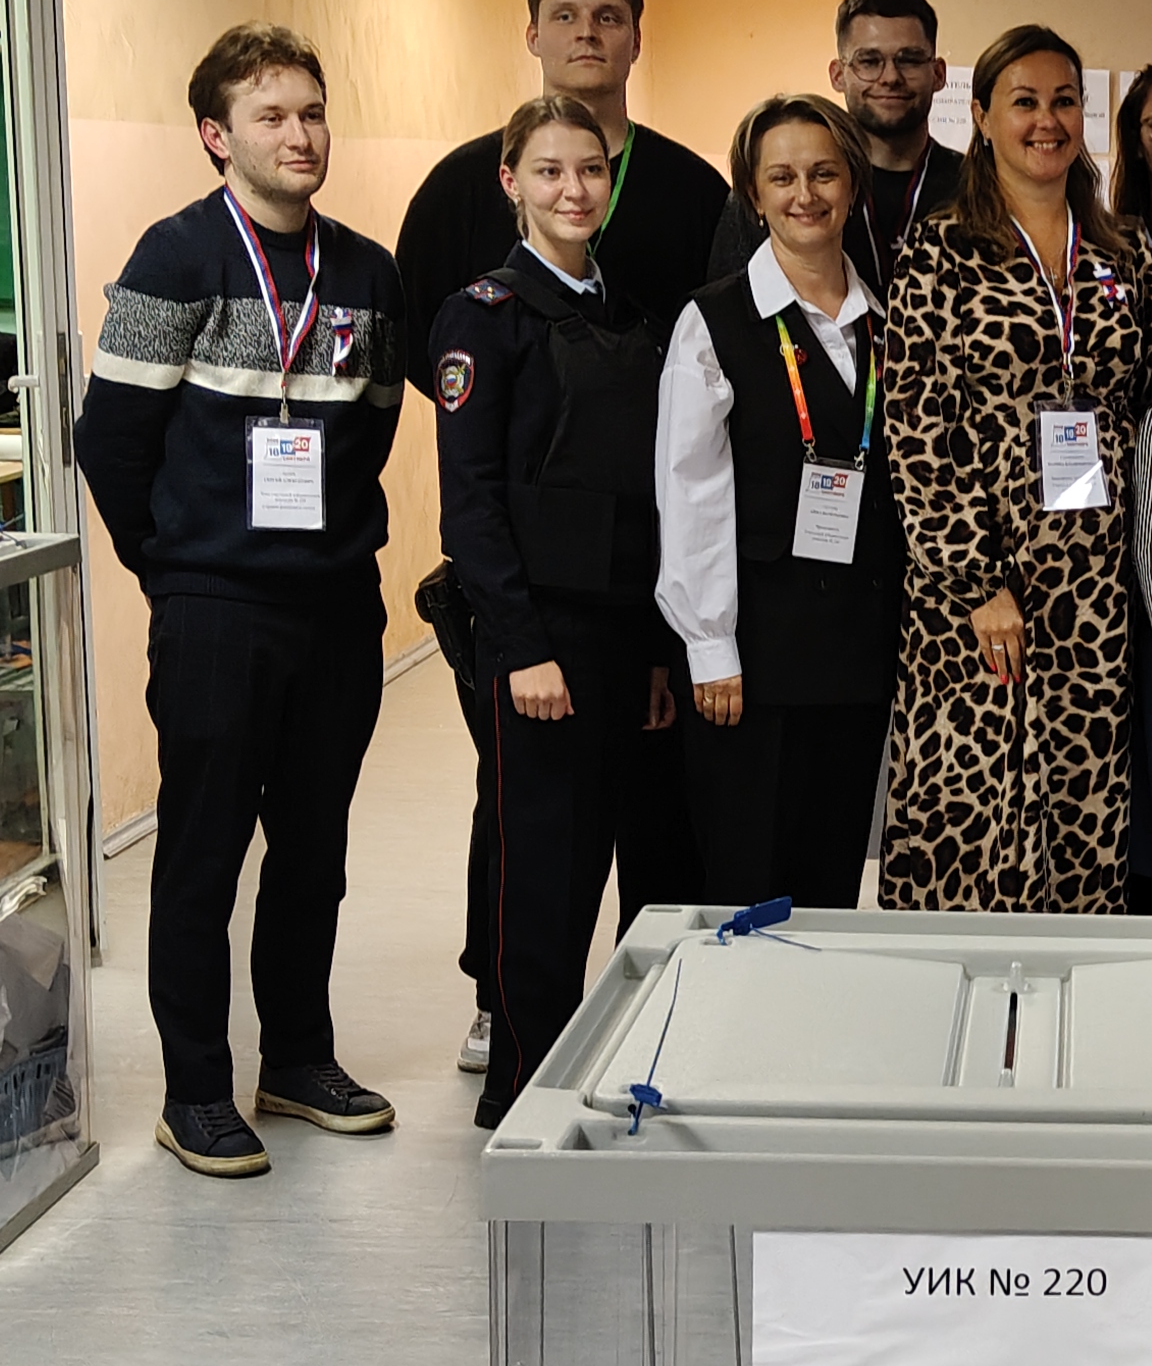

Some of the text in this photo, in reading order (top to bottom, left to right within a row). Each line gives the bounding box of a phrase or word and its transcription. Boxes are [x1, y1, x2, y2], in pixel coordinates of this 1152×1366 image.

[902, 1267, 1107, 1297] УИК № 220
